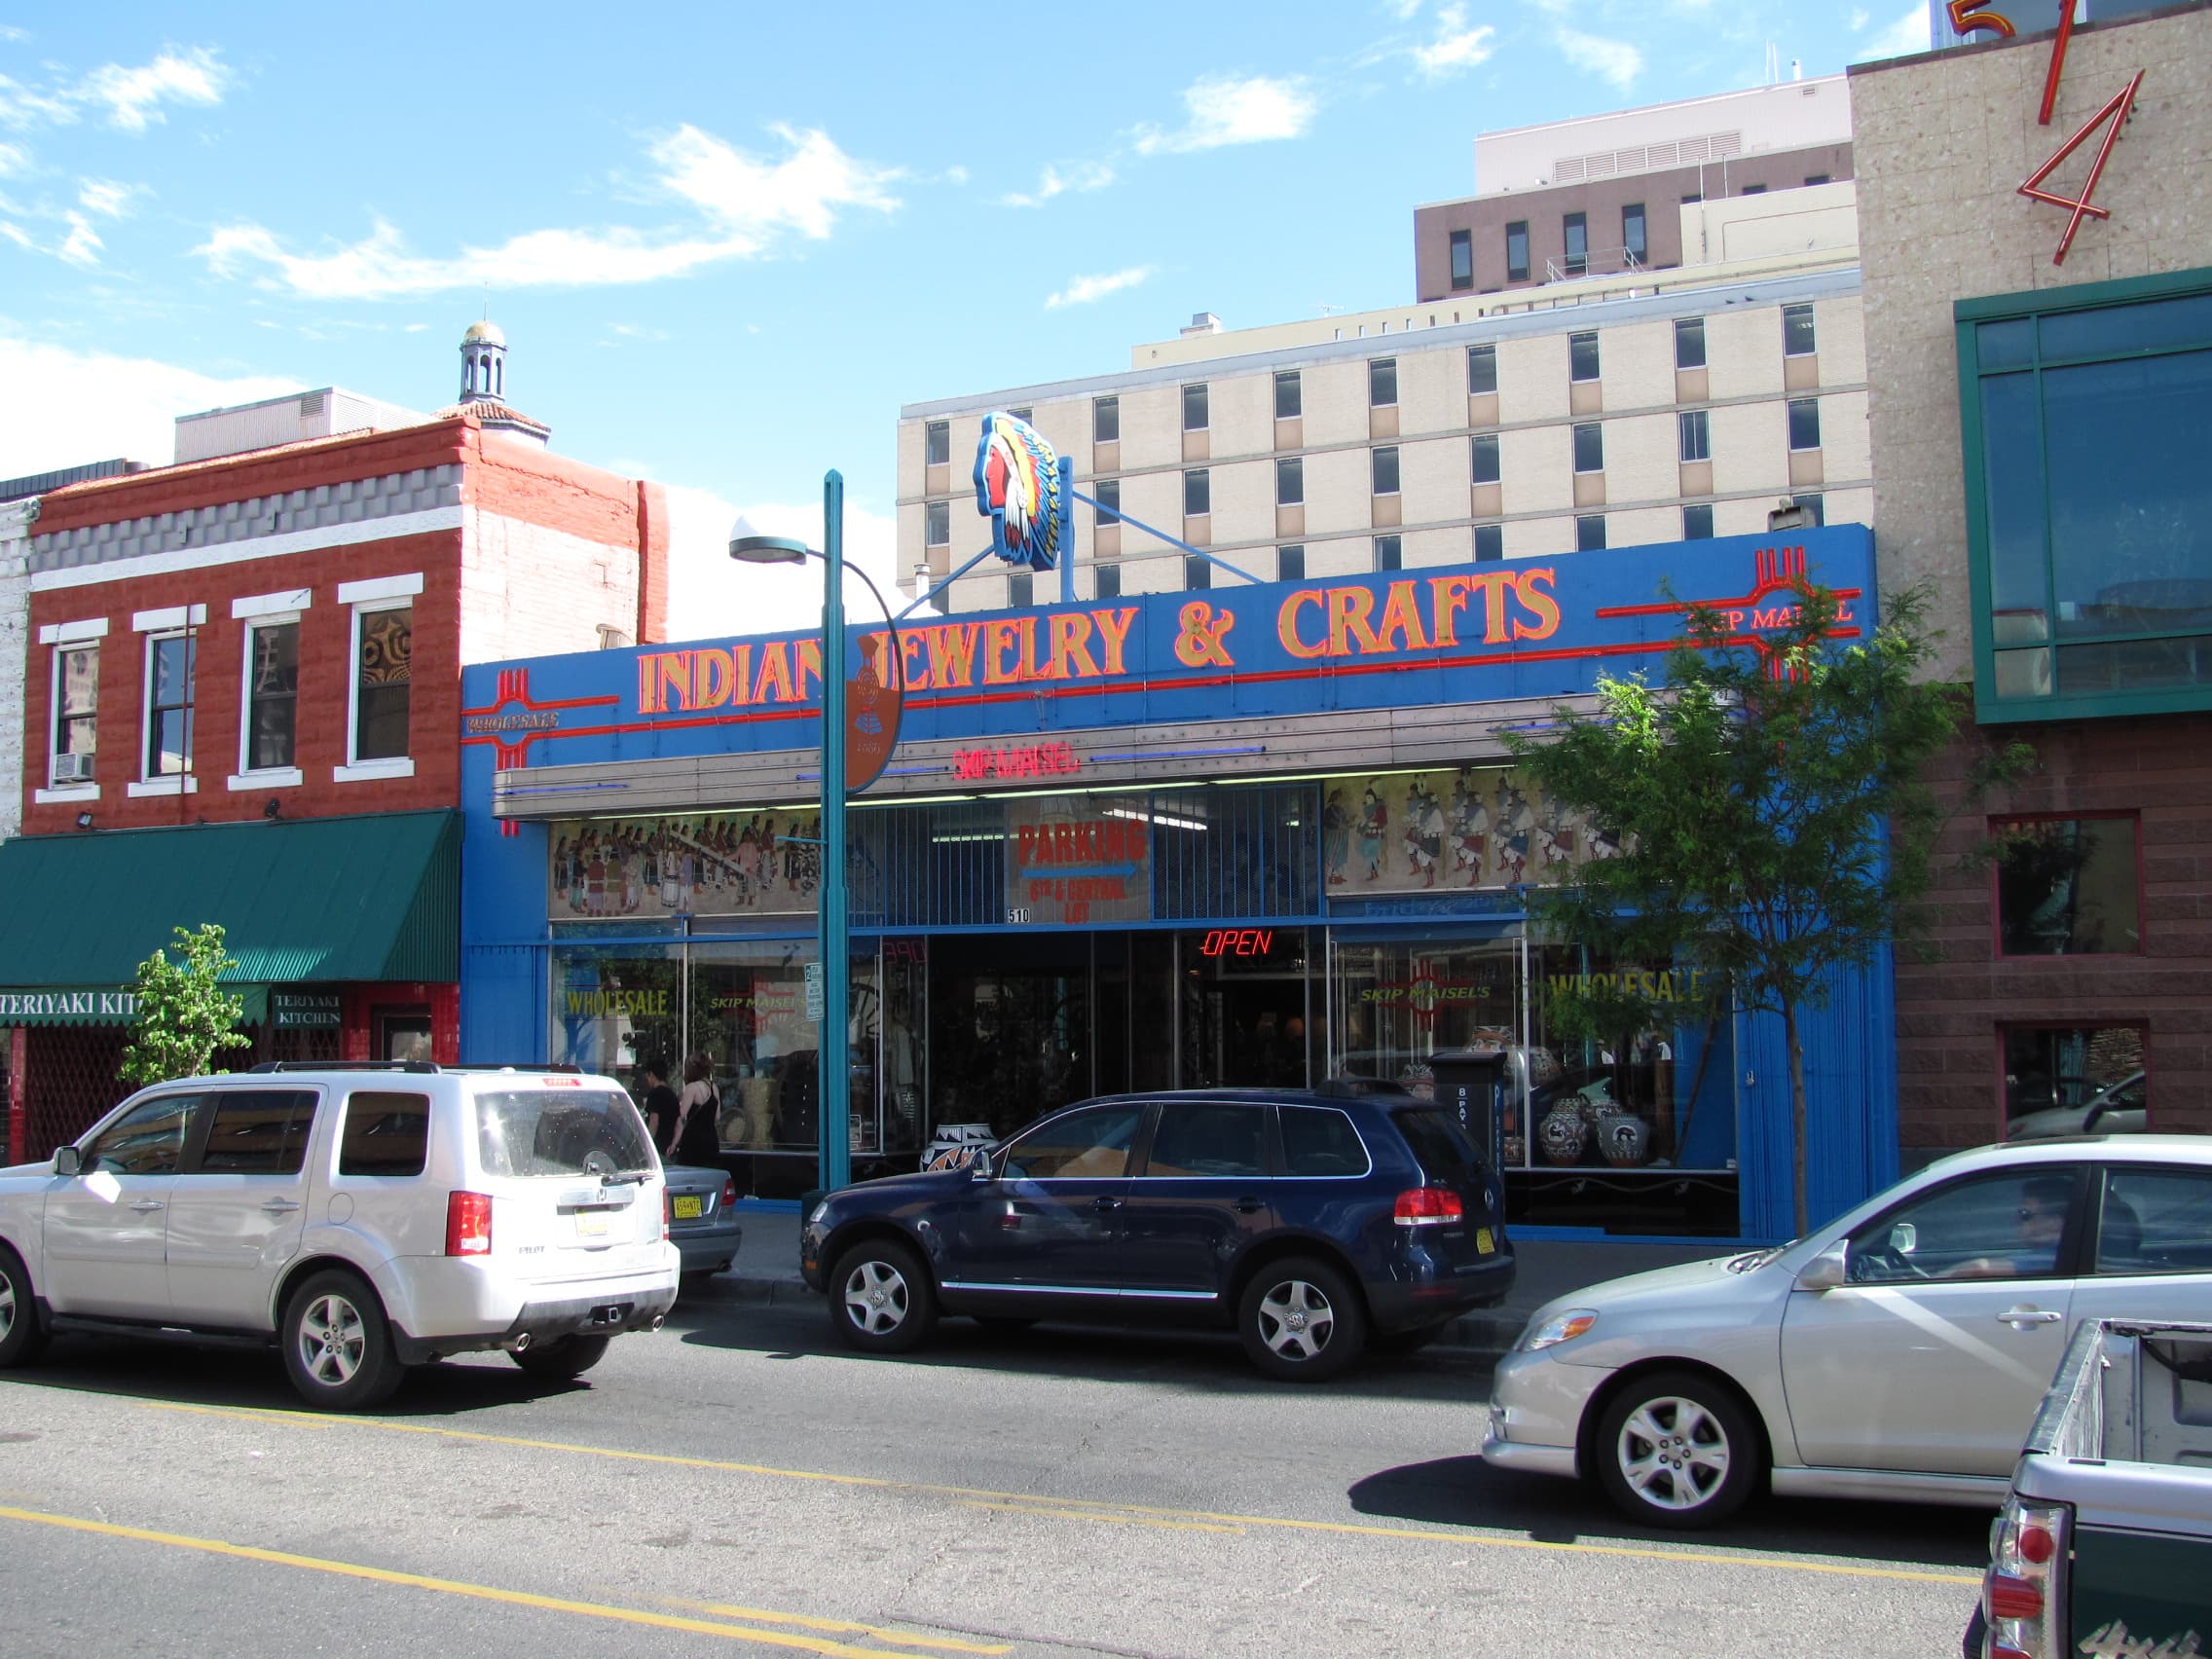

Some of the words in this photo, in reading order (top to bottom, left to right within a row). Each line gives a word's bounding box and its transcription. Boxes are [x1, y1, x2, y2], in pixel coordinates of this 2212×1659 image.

[638, 639, 822, 714] INDIAN
[869, 607, 1139, 692] JEWELRY
[1174, 601, 1235, 667] &
[1278, 569, 1560, 659] CRAFTS
[1017, 820, 1146, 865] PARKING
[1009, 909, 1030, 923] 510
[1203, 930, 1272, 955] OPEN
[275, 995, 340, 1007] TERIYAKI
[1361, 989, 1403, 1001] SKIP
[1409, 986, 1491, 999] MAISEL'S
[0, 993, 94, 1014] TERIYAKI
[568, 990, 668, 1015] WHOLESALE
[710, 997, 742, 1009] SKIP
[279, 1013, 341, 1023] KITCHEN
[1458, 1088, 1466, 1097] 8
